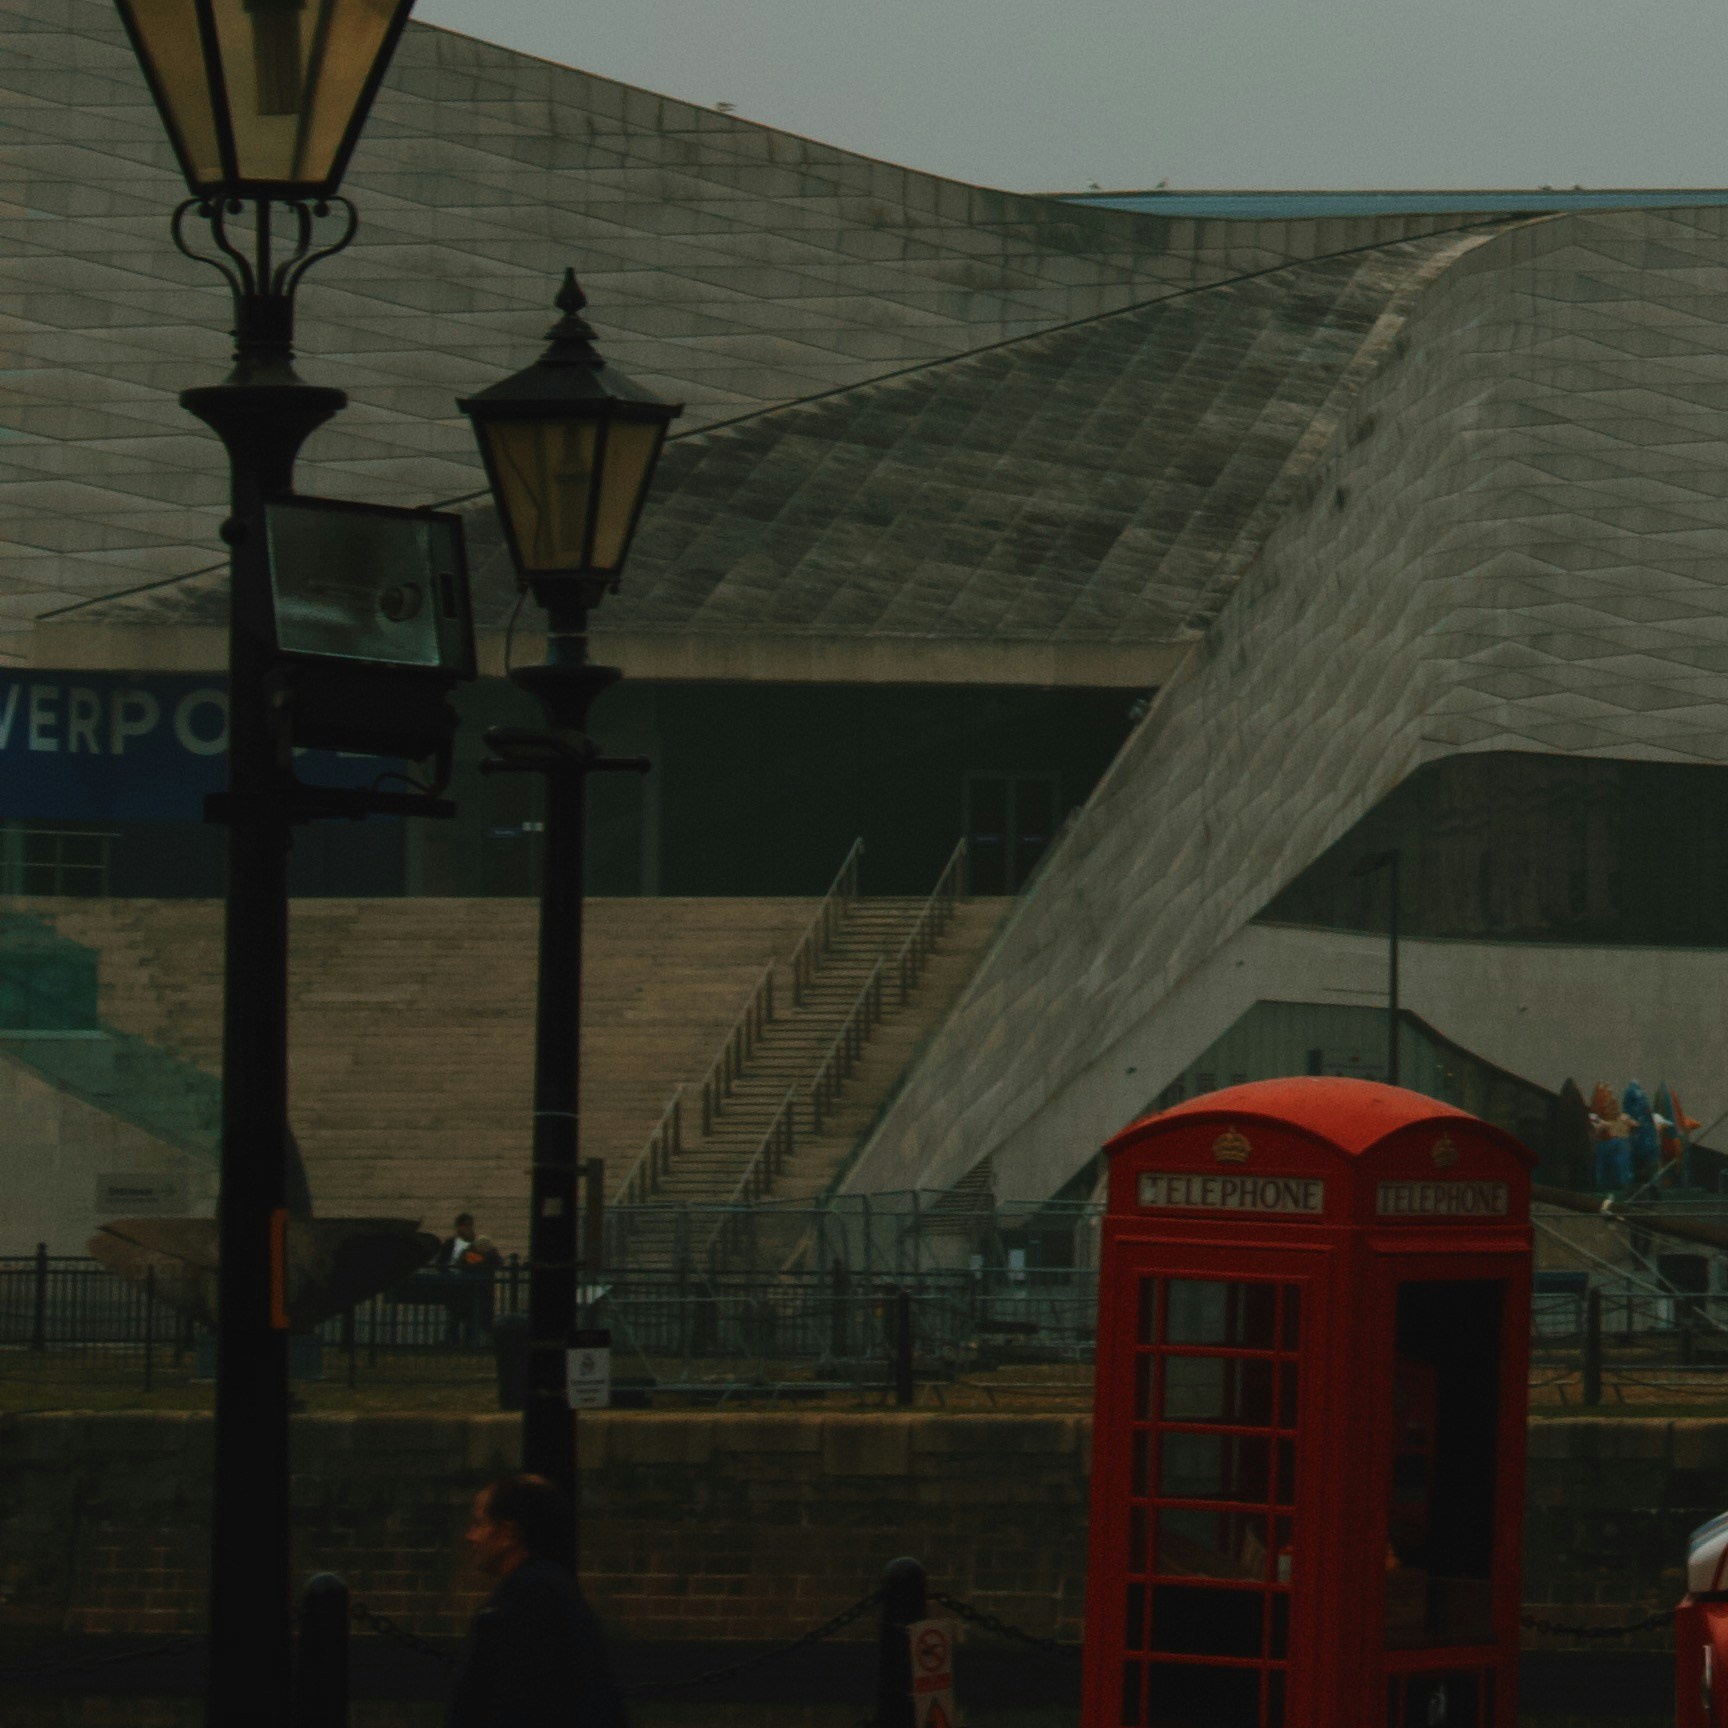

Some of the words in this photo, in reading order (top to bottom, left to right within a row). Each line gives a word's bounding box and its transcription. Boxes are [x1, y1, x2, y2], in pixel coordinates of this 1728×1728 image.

[0, 683, 378, 758] VERPO
[1145, 1175, 1321, 1210] TELEPHONE
[1380, 1183, 1508, 1215] TELEPHONE
